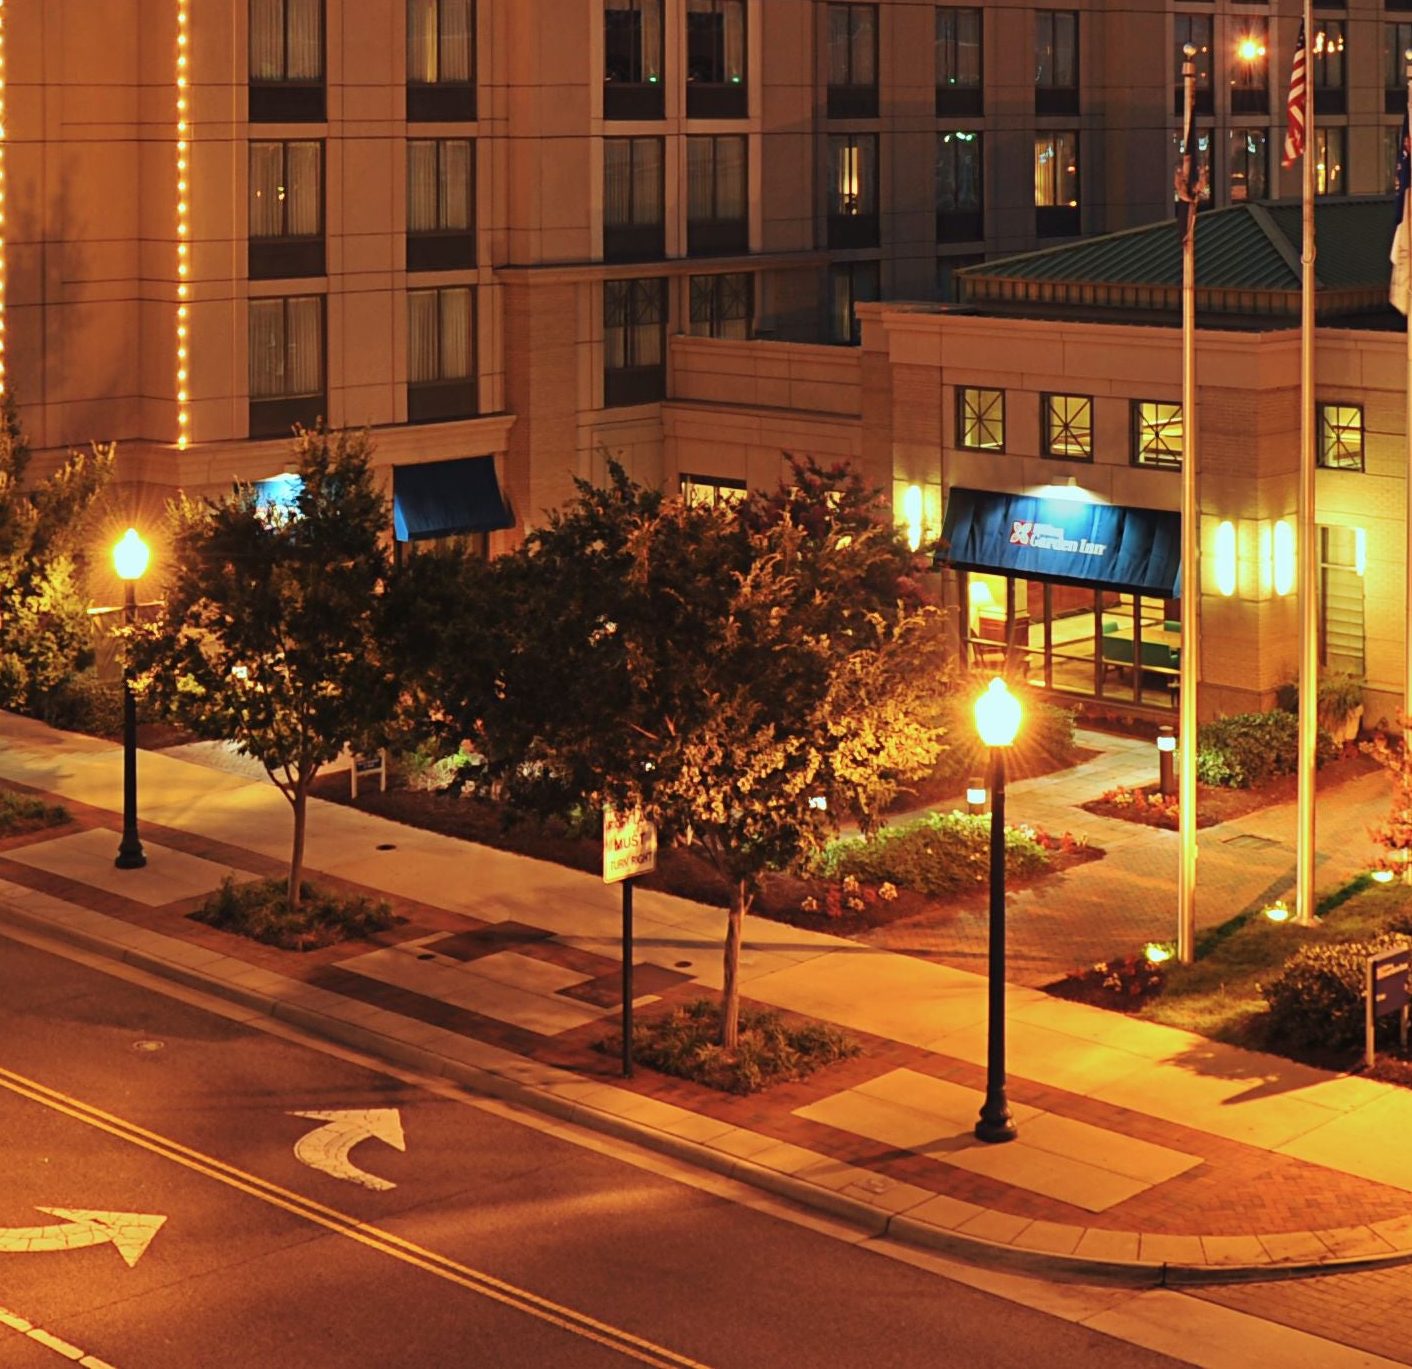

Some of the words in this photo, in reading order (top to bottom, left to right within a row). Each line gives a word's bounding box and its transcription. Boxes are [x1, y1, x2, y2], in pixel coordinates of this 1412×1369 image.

[614, 832, 647, 851] MUST
[611, 857, 629, 871] TURN
[631, 852, 652, 866] RIGHT
